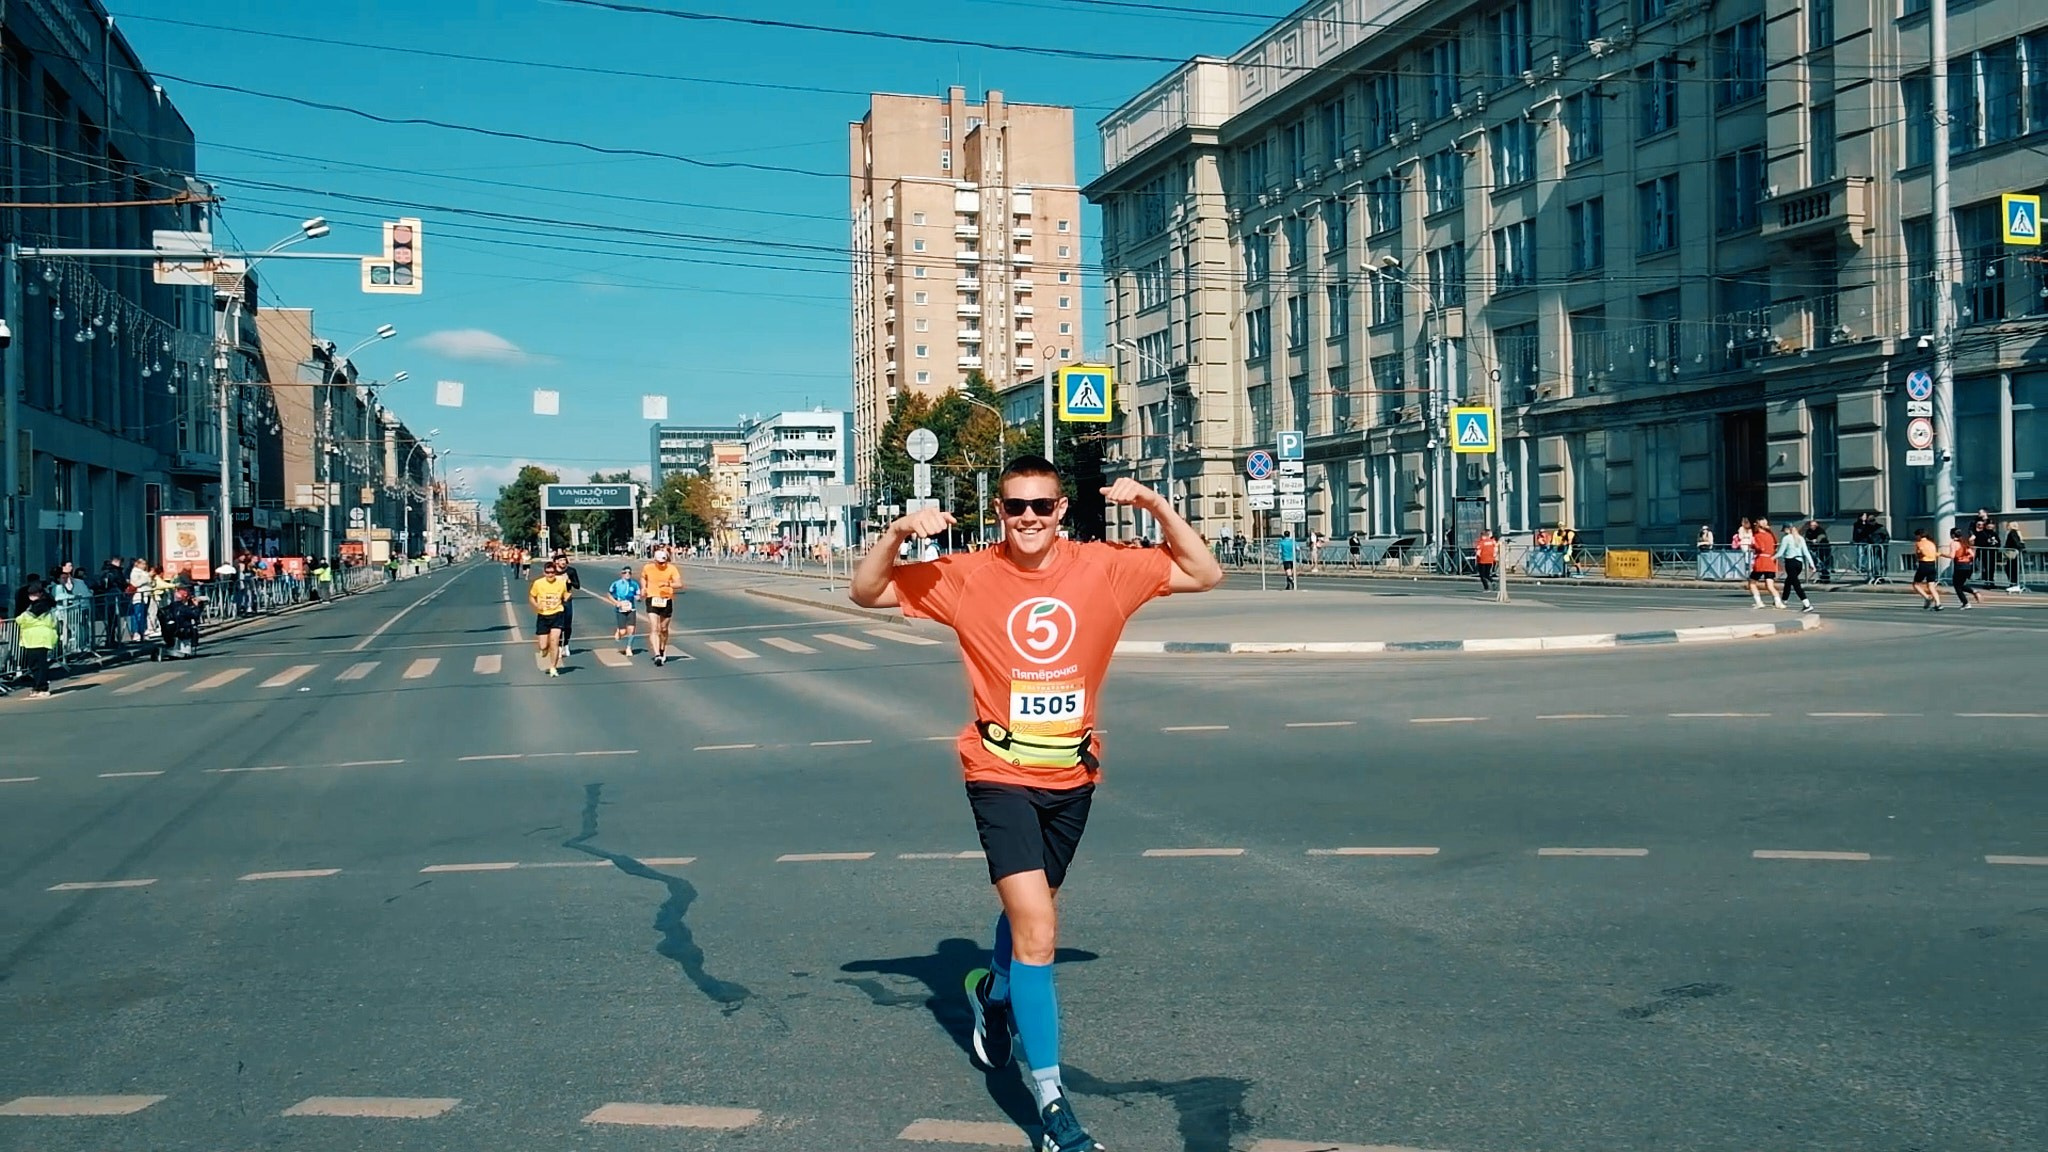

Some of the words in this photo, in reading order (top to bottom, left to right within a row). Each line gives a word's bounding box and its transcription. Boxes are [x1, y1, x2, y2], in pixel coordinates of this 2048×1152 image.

[1283, 434, 1297, 456] P
[1026, 601, 1058, 651] 5
[1011, 664, 1078, 682] Пятёрочка
[1020, 693, 1076, 715] 1505
